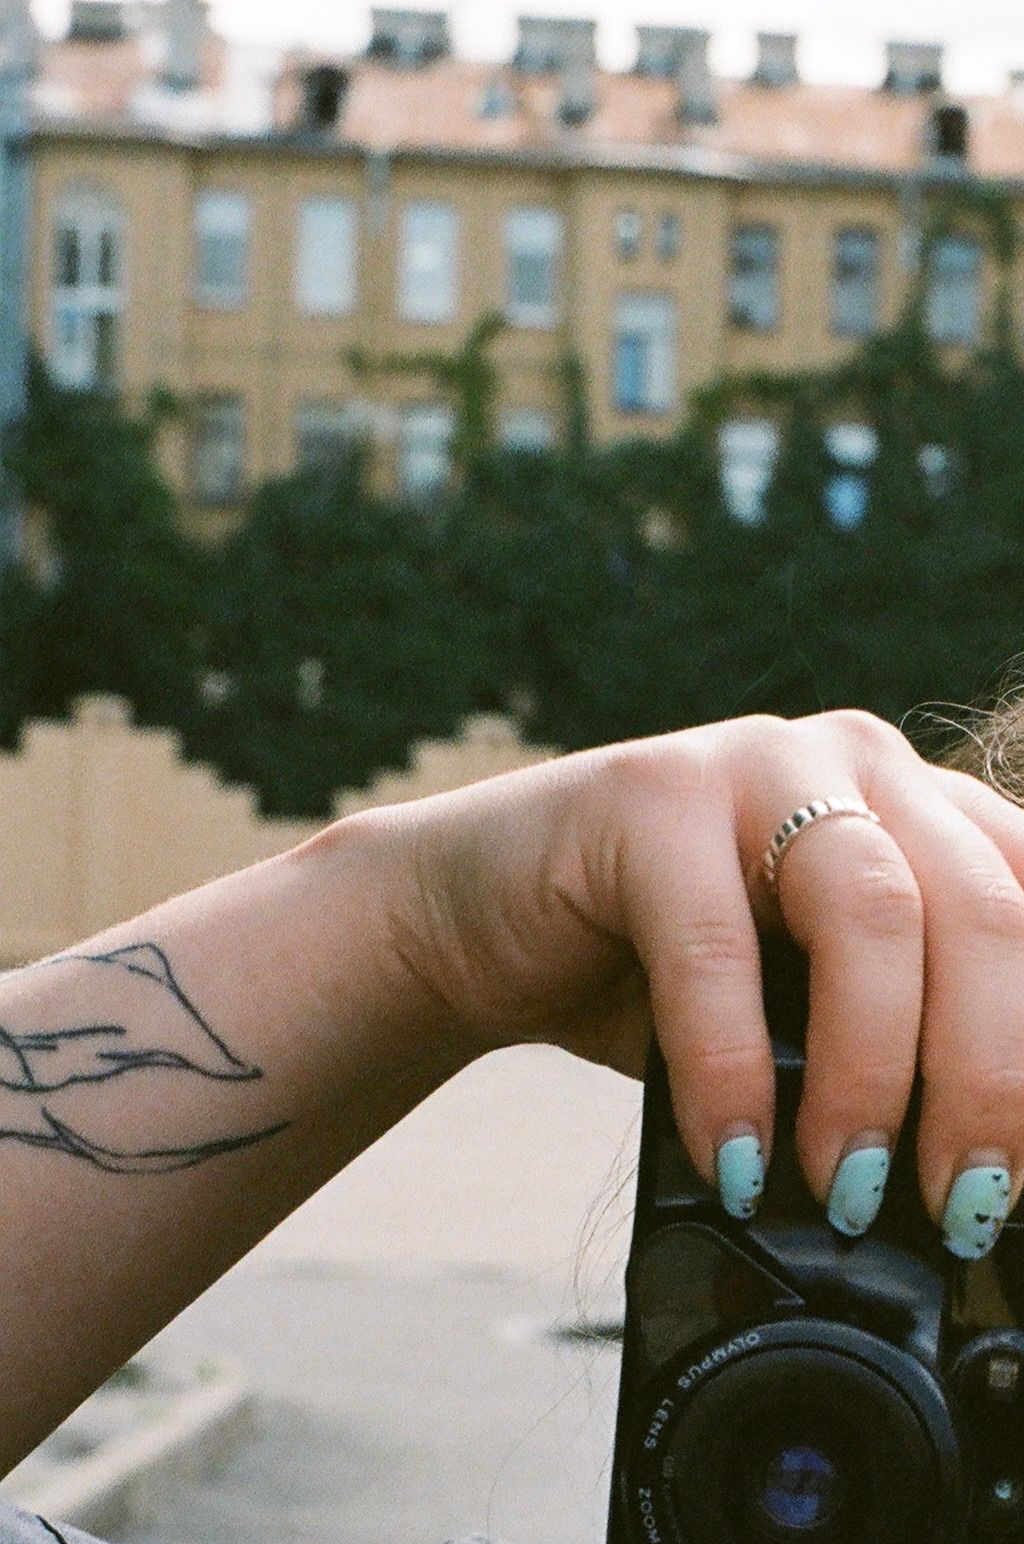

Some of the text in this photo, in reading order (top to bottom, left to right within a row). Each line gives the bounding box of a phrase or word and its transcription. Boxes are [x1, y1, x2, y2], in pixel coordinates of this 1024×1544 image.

[677, 1331, 761, 1391] OLYMPUS
[644, 1397, 675, 1450] LENS
[637, 1486, 661, 1544] ZOOM
